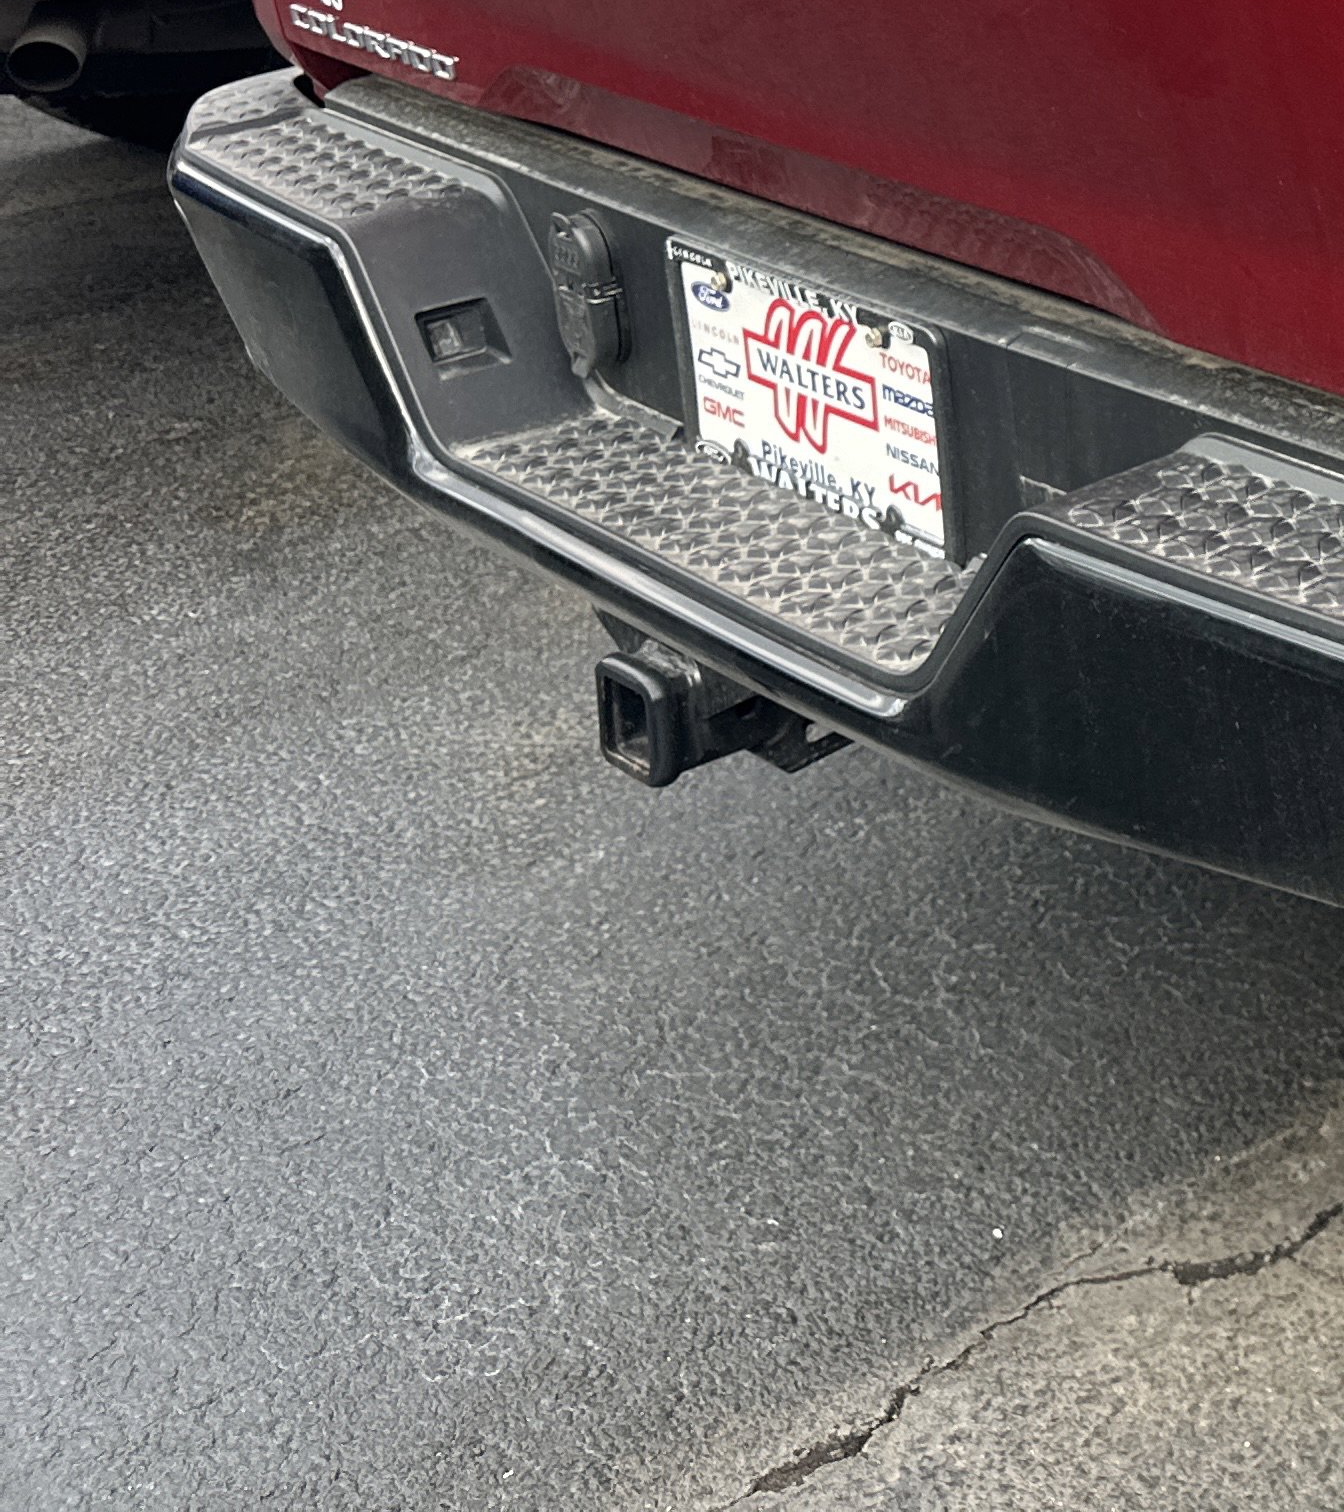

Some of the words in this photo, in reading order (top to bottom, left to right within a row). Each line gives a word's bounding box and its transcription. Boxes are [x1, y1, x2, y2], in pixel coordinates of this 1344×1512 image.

[289, 3, 460, 81] COLORADO
[829, 298, 858, 327] KY
[692, 319, 740, 345] LINCOLN
[757, 347, 865, 410] WALTERS
[879, 351, 931, 385] TOYOTA
[703, 396, 745, 428] GMC
[884, 415, 938, 447] MITSUBISH
[886, 442, 940, 477] NISSAN
[850, 477, 876, 507] KY
